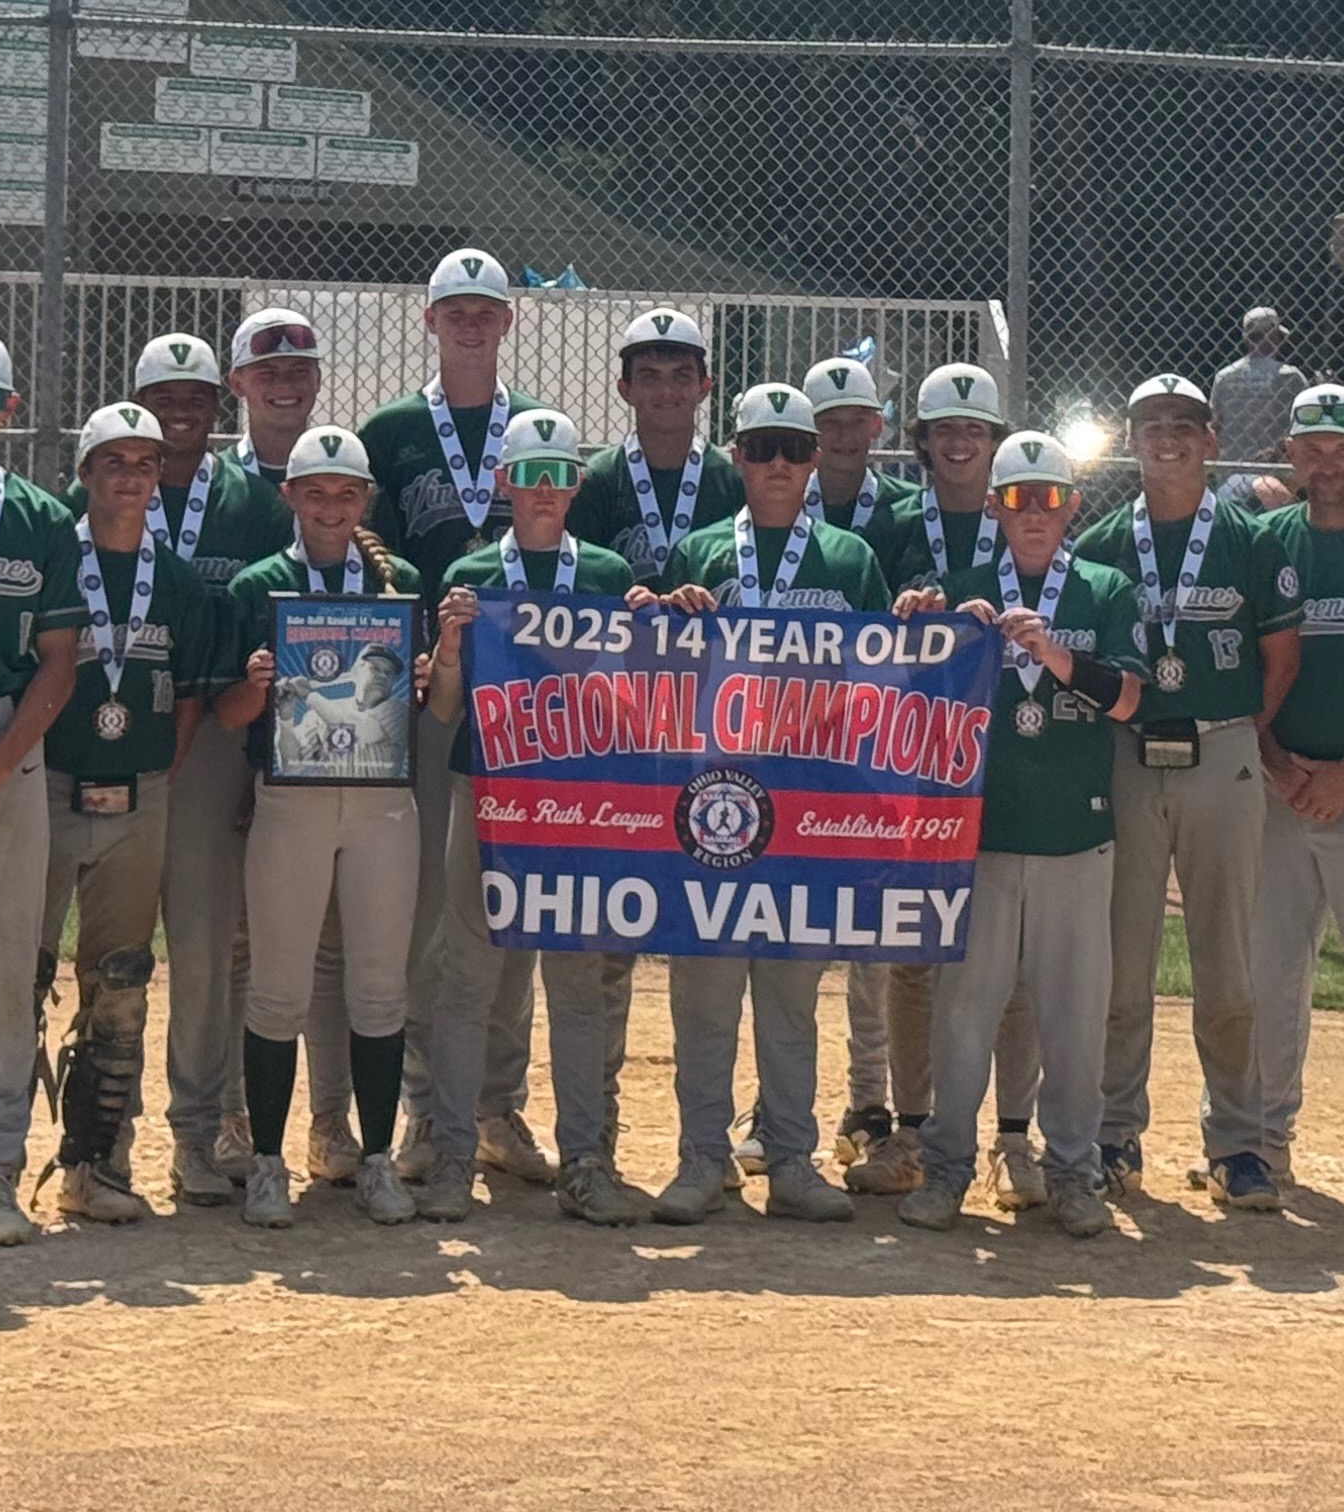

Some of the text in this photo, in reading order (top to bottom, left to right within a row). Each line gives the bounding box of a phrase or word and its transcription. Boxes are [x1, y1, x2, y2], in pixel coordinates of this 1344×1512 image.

[460, 258, 484, 280] V
[651, 315, 674, 336] V
[169, 343, 192, 366] V
[827, 367, 850, 390] V
[950, 376, 976, 401] V
[766, 391, 790, 414] V
[118, 408, 142, 429] V
[532, 419, 557, 442] V
[319, 435, 343, 458] V
[1019, 441, 1043, 464] V
[513, 603, 956, 666] 2025 14 YEAR OLD
[1207, 628, 1243, 671] 13
[472, 671, 992, 788] REGIONAL CHAMPIONS
[687, 769, 766, 799] OHIO VALLEY
[477, 796, 664, 834] Babe Ruth League
[796, 810, 965, 840] Established 1951
[692, 847, 754, 868] REGION
[482, 870, 971, 947] OHIO VALLEY
